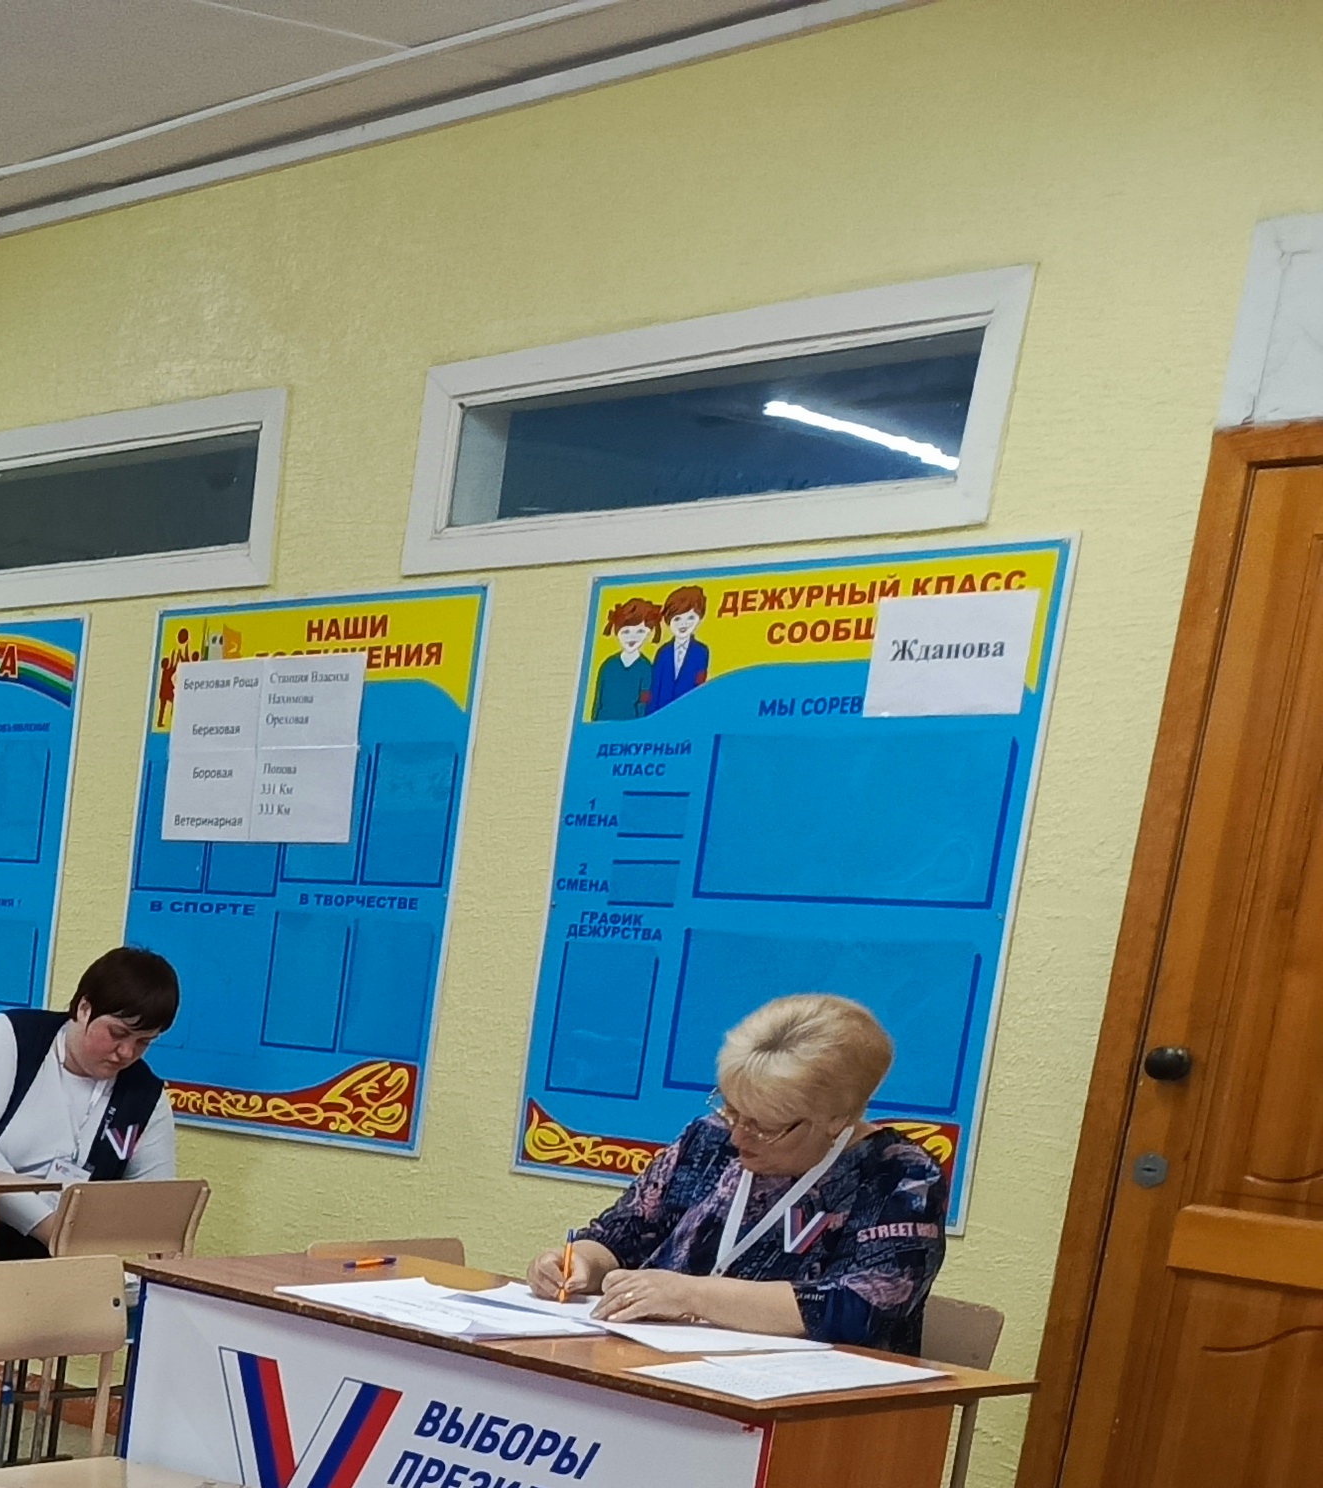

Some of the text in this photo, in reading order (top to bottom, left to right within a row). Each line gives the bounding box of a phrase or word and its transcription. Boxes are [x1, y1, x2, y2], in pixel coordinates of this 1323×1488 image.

[717, 574, 901, 618] ДЕЖУРНЫЙ
[306, 614, 388, 642] НАШИ
[890, 639, 1005, 663] Жданова
[183, 676, 259, 692] Березовая Роща
[758, 695, 864, 717] МЫ СОРЕВ
[192, 724, 240, 737] Березовая
[596, 739, 692, 759] ДЕЖУРНЫЙ
[192, 767, 233, 781] Боровая
[612, 763, 666, 777] КЛАСС
[589, 797, 597, 811] 1
[174, 814, 243, 828] Ветеринарная
[564, 814, 619, 827] СМЕНА
[578, 862, 588, 876] 2
[556, 878, 610, 893] СМЕНА
[150, 900, 256, 916] В СПОРТЕ
[299, 893, 419, 911] В ТВОРЧЕСТВЕ
[580, 911, 644, 926] ГРАФИК
[566, 924, 663, 941] ДЕЖУРСТВА
[857, 1222, 914, 1243] STREET
[415, 1400, 601, 1480] ВЫБОРЫ
